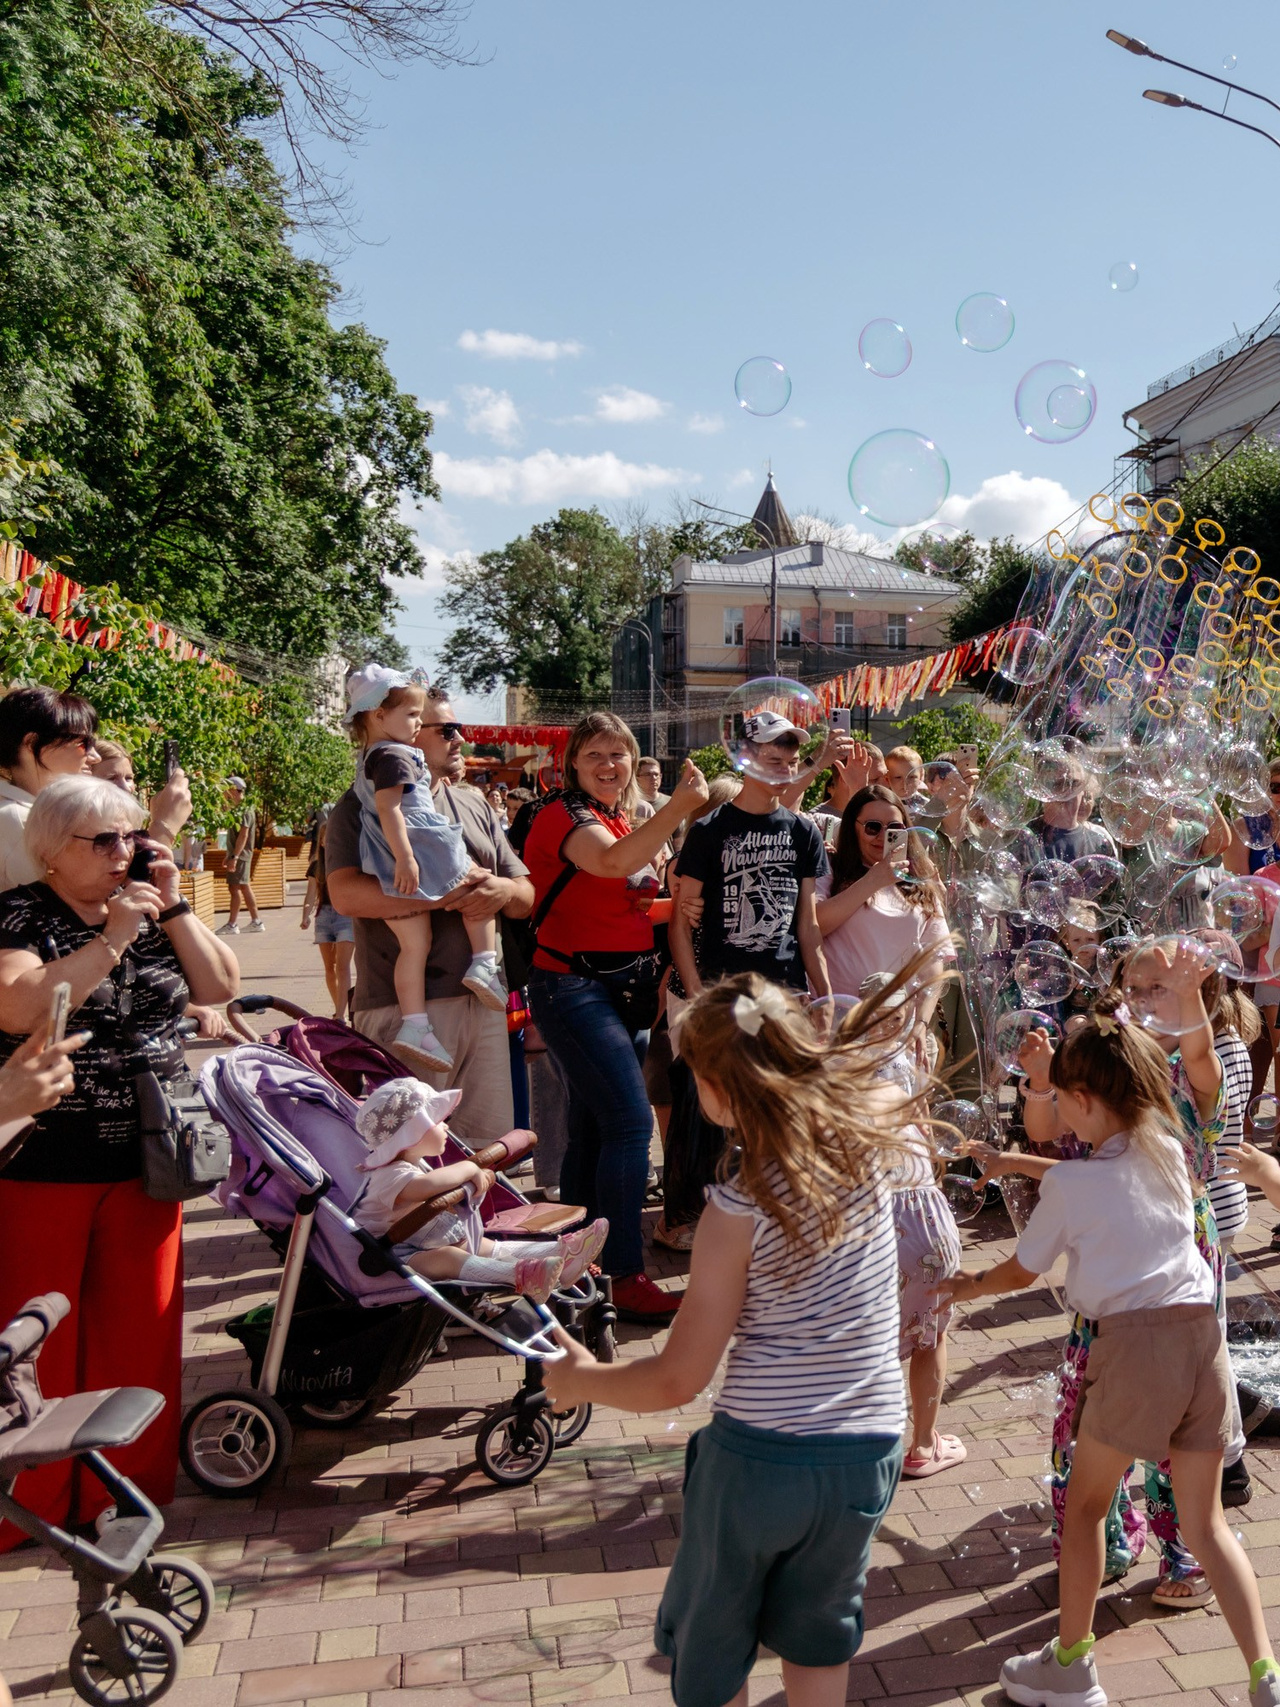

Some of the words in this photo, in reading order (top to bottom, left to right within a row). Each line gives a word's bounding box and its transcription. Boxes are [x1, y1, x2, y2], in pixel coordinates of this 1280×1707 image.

[738, 831, 793, 850] Atlantic
[721, 845, 797, 874] Navigation
[723, 884, 738, 897] 19
[723, 901, 738, 913] 83
[91, 1085, 110, 1096] Like
[94, 1098, 123, 1110] STAR
[281, 1366, 353, 1392] Nuovita
